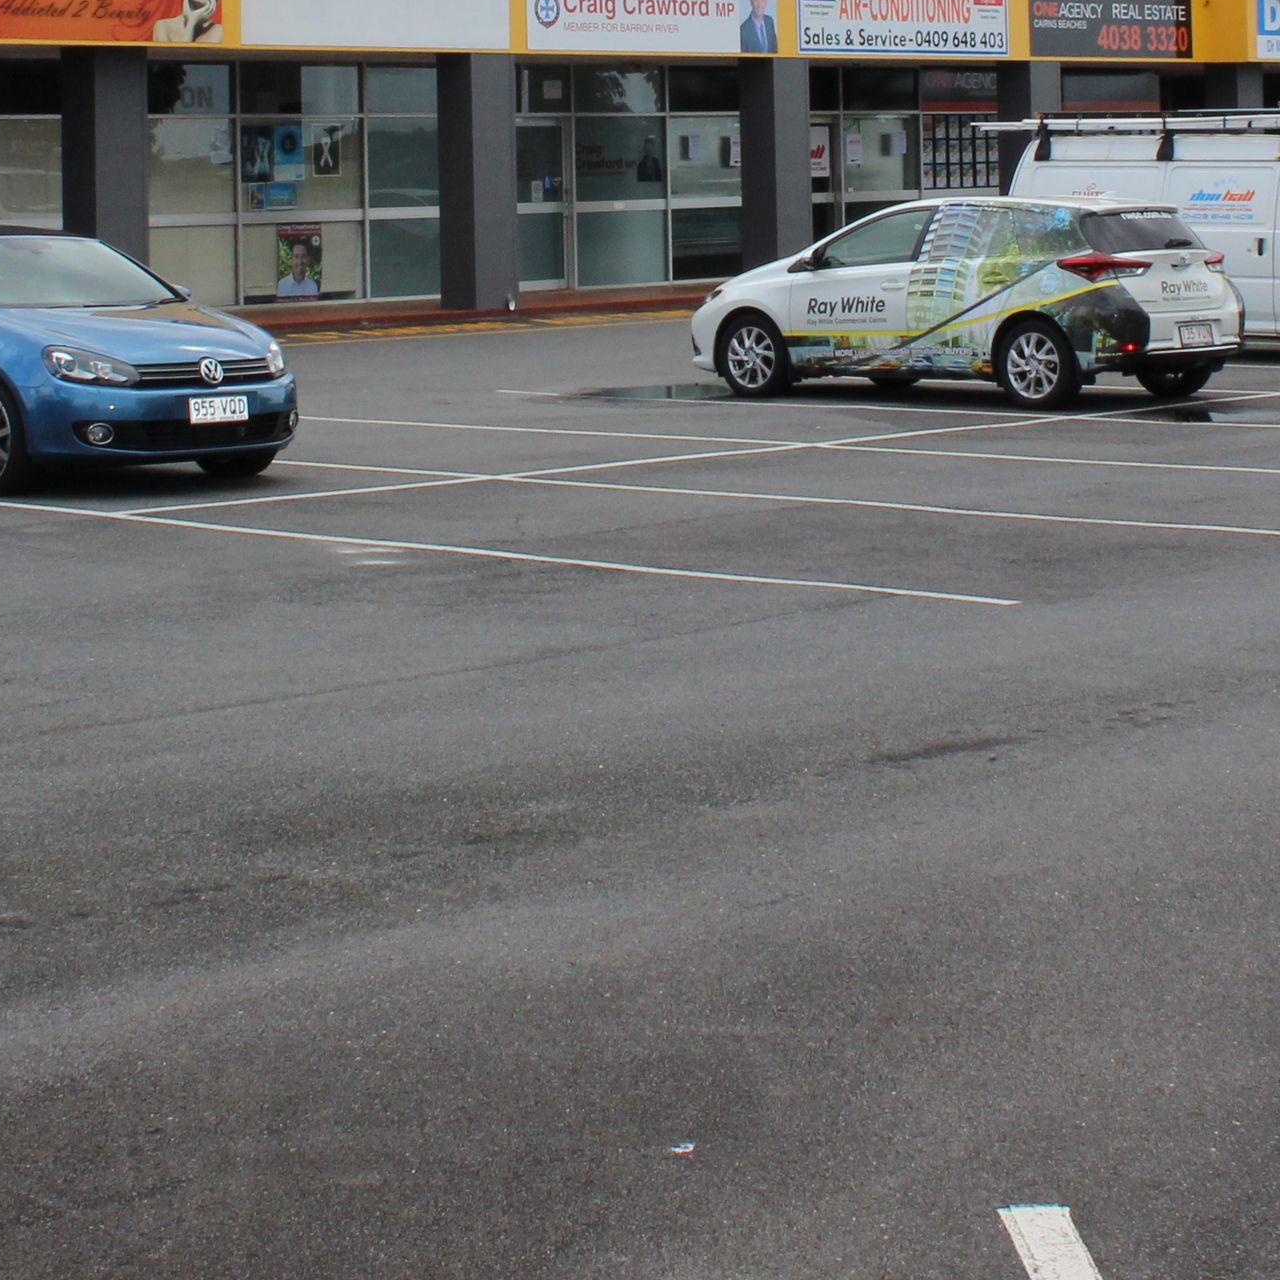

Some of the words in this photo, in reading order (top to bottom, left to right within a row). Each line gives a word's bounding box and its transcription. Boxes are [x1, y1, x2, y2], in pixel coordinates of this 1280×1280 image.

[72, 0, 84, 19] 2
[716, 3, 735, 17] MP
[1112, 3, 1142, 19] REAL
[1144, 4, 1186, 20] ESTATE
[563, 22, 599, 32] MEMBER
[601, 23, 619, 32] FOR
[620, 23, 654, 33] BARRON
[656, 24, 679, 33] RIVER
[1033, 20, 1057, 29] CAIRNS
[1058, 20, 1087, 29] BEACHES
[804, 27, 840, 46] Sales
[845, 29, 854, 46] &
[952, 31, 976, 48] 648
[980, 31, 1004, 48] 403
[1097, 24, 1142, 50] 4038
[1147, 26, 1188, 51] 3320
[1267, 40, 1275, 52] Dr
[1161, 280, 1181, 296] Ray
[1182, 280, 1208, 293] White
[808, 298, 837, 317] Ray
[841, 296, 886, 313] White
[193, 400, 216, 416] 955
[220, 398, 246, 414] VQD
